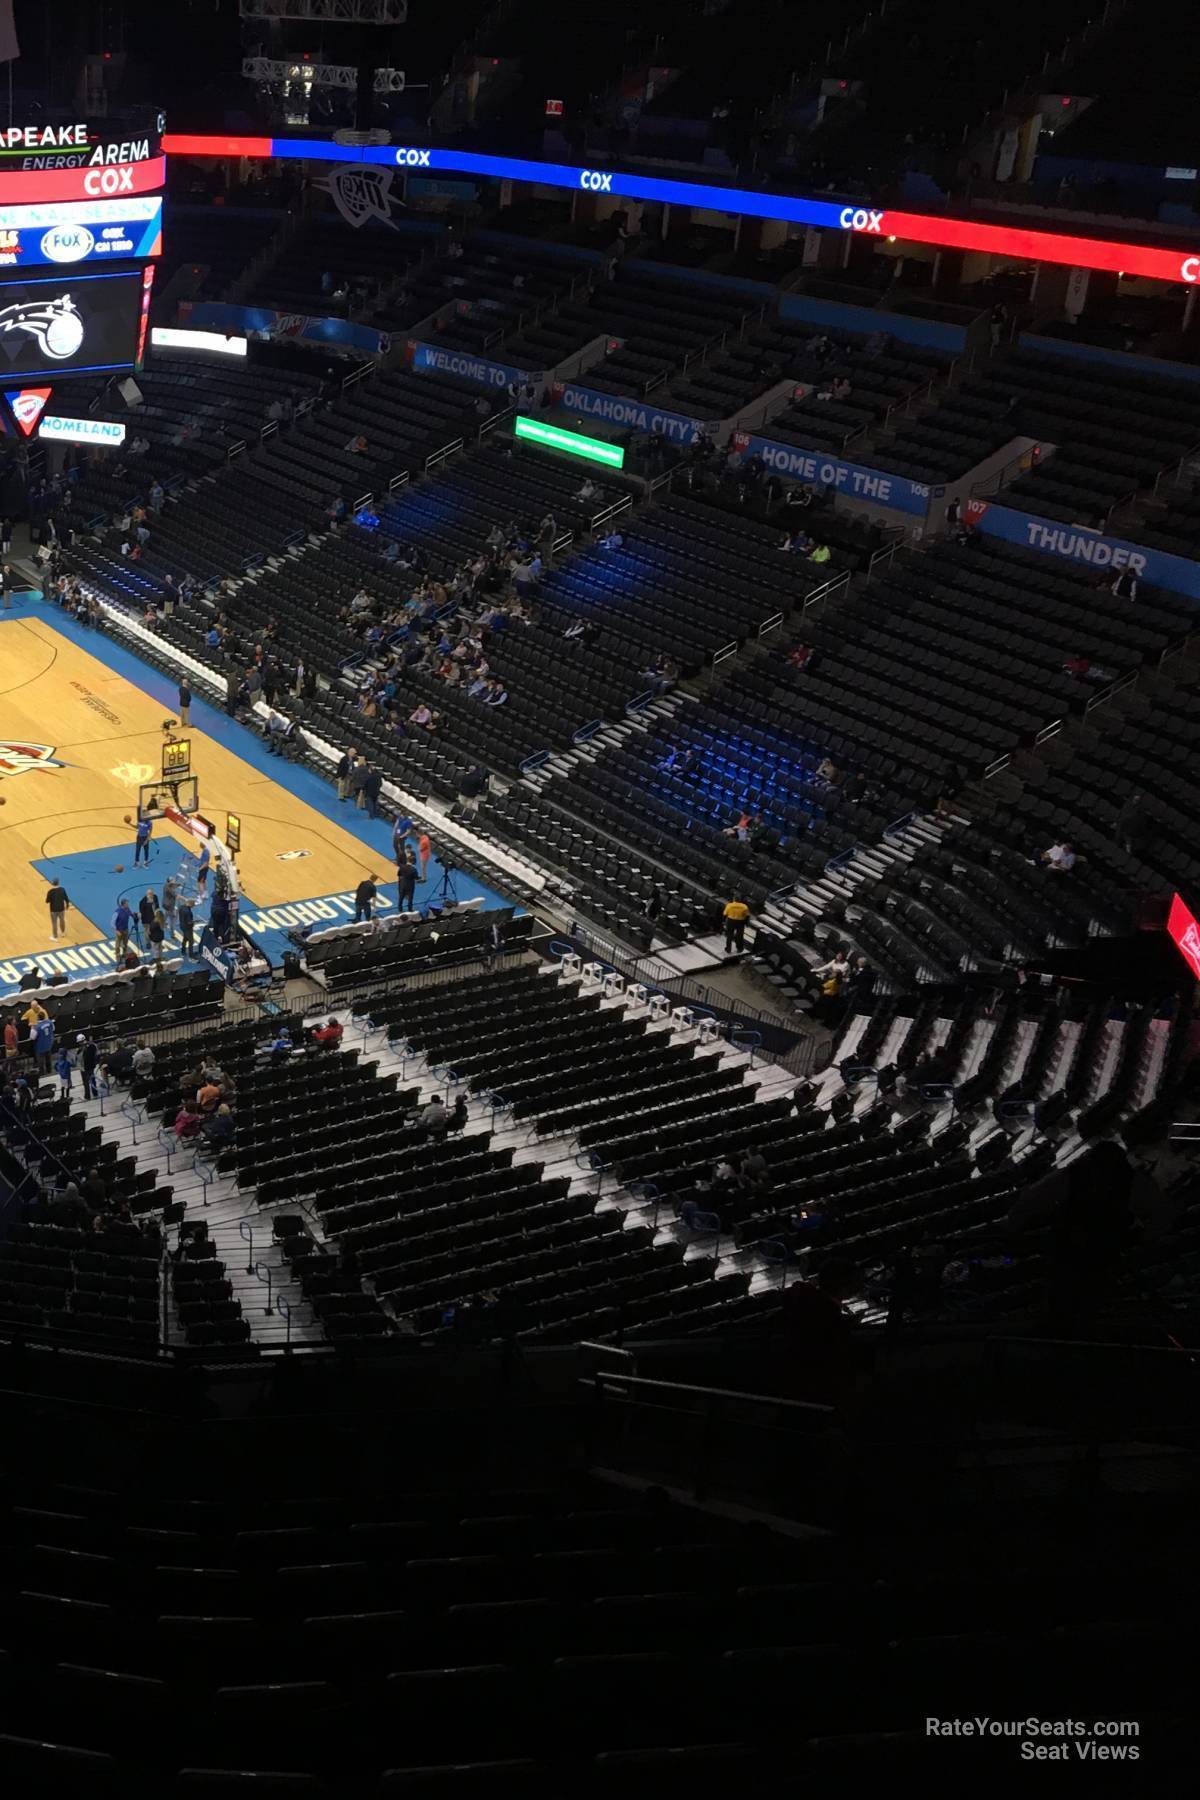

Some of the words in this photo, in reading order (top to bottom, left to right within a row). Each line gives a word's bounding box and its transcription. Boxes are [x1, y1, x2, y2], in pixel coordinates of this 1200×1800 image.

[22, 154, 87, 171] ENERGY
[89, 139, 150, 167] ARENA
[395, 148, 431, 167] COX
[84, 166, 134, 195] COX
[580, 170, 613, 192] COX
[840, 207, 884, 232] COX
[53, 232, 82, 248] FOX
[425, 349, 486, 381] WELCOME
[489, 367, 507, 387] TO
[563, 389, 647, 430] OKLAHOMA
[651, 414, 691, 440] CITY
[42, 418, 122, 437] HOMELAND
[735, 432, 750, 446] 106
[761, 446, 817, 478] HOME
[820, 463, 848, 486] OF
[852, 471, 892, 501] THE
[911, 483, 929, 498] 106
[967, 499, 987, 514] 107
[1026, 522, 1148, 577] THUNDER
[202, 945, 230, 980] SPALDING
